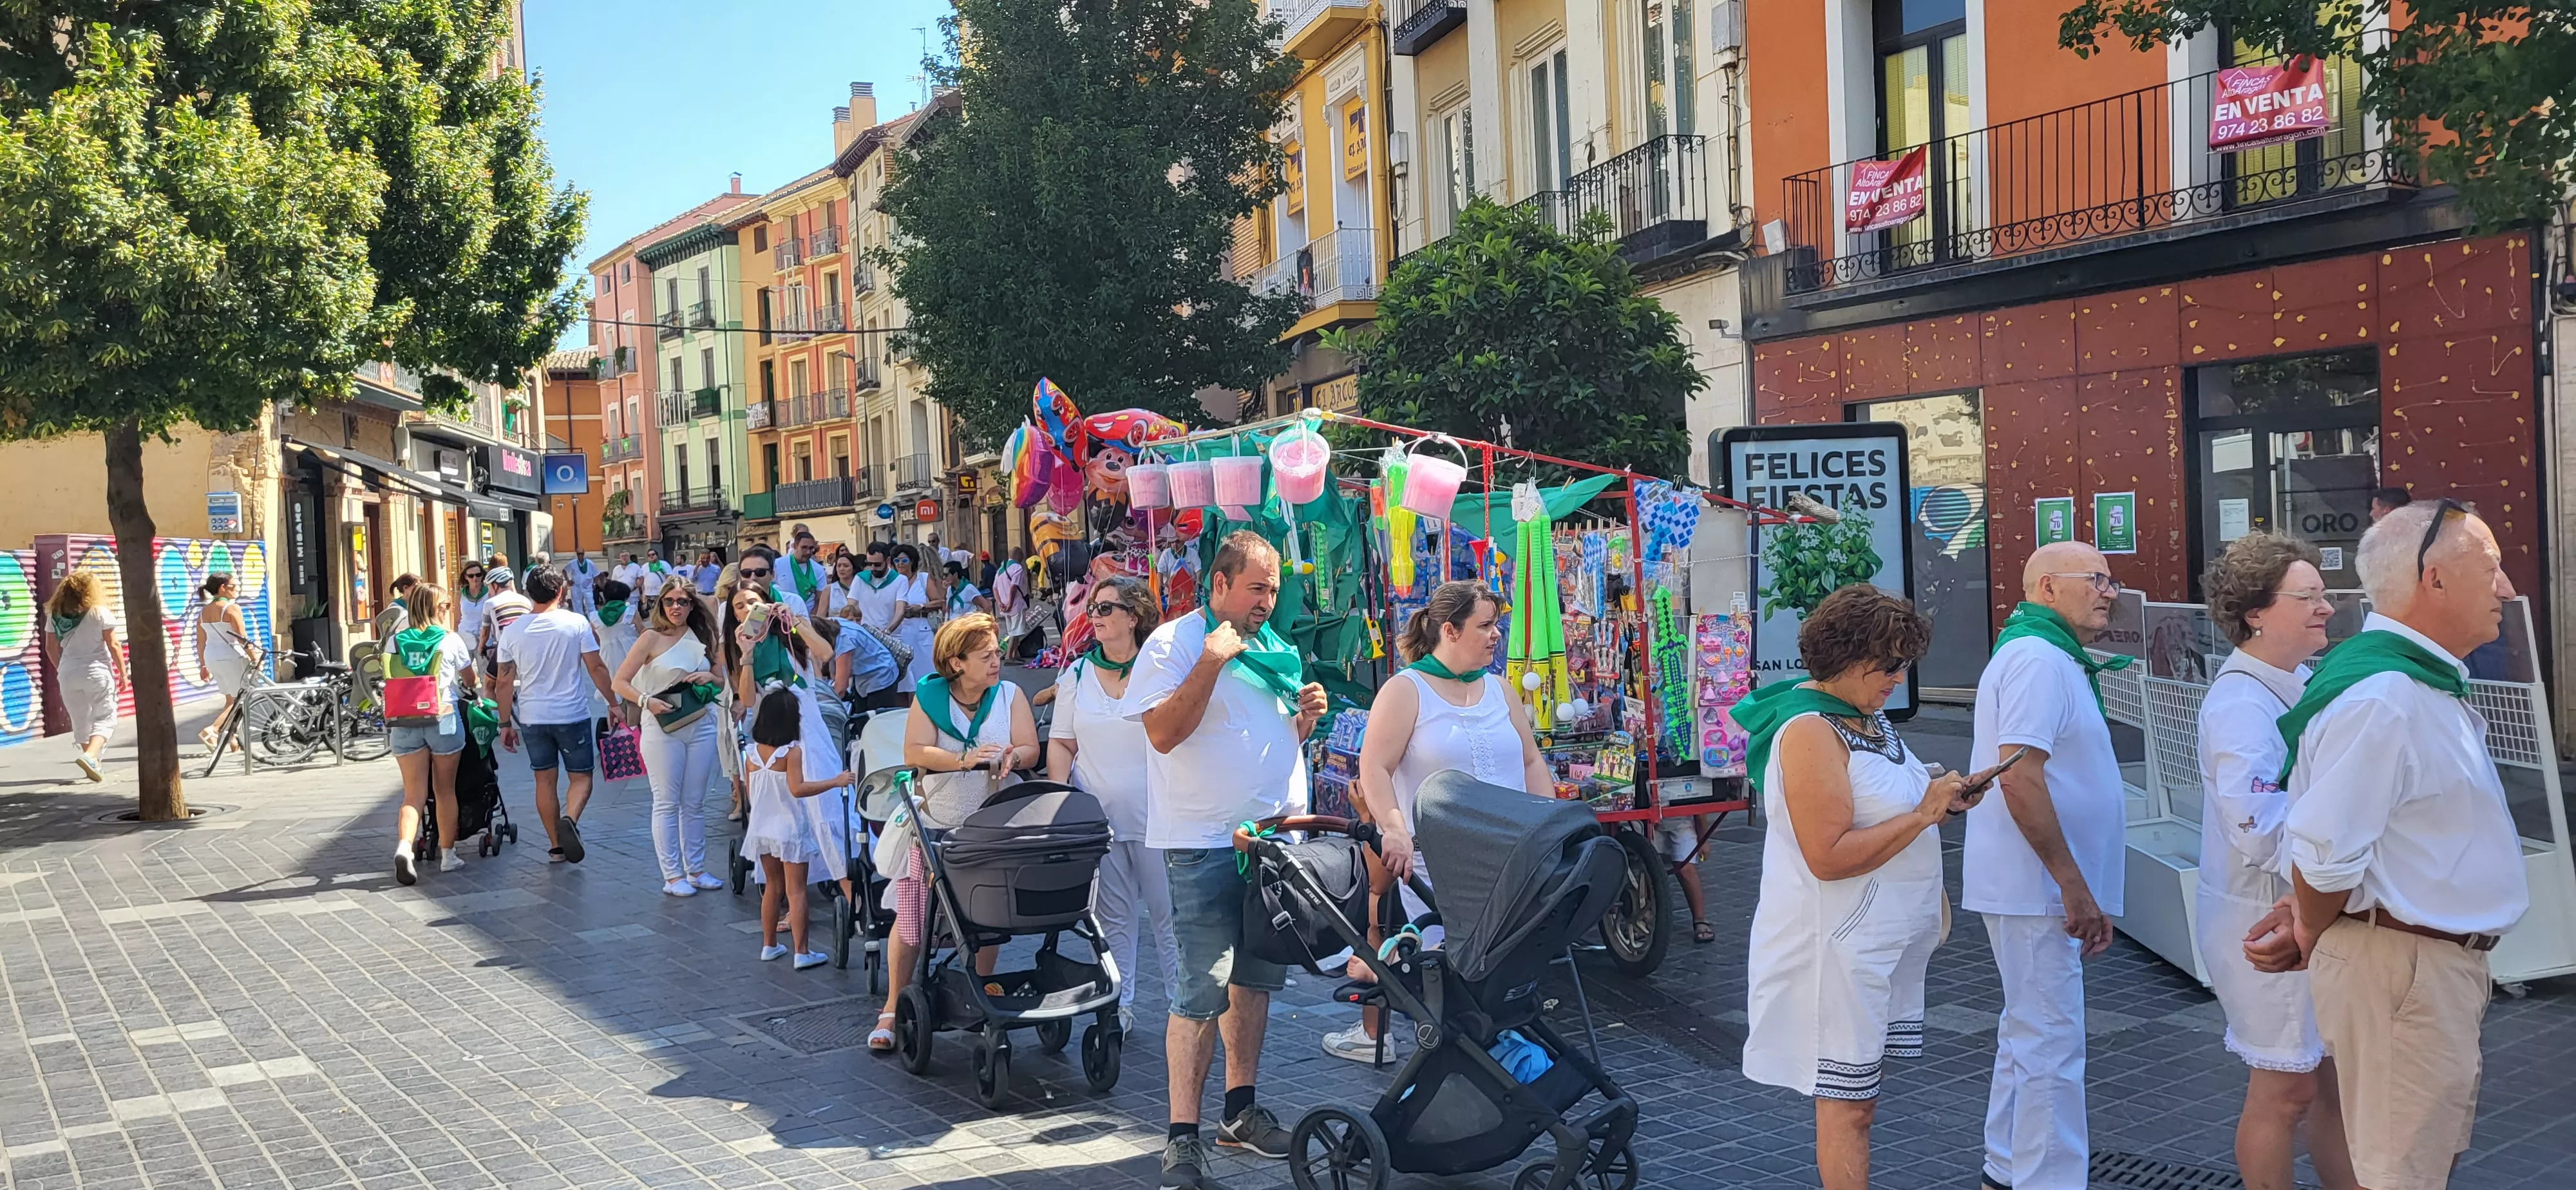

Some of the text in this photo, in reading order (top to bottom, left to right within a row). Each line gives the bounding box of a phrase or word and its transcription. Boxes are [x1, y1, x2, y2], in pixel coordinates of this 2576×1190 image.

[2232, 75, 2273, 87] FINCAS
[2214, 83, 2324, 122] EN VENTA
[2217, 106, 2324, 140] 974 23 86 82
[1849, 175, 1923, 206] EN VENTA
[1850, 194, 1922, 222] 974 23 86 82
[1745, 449, 1886, 480] FELICES
[1747, 482, 1888, 510] FIESTAS
[2302, 513, 2358, 533] ORO
[1754, 659, 1781, 672] SAN
